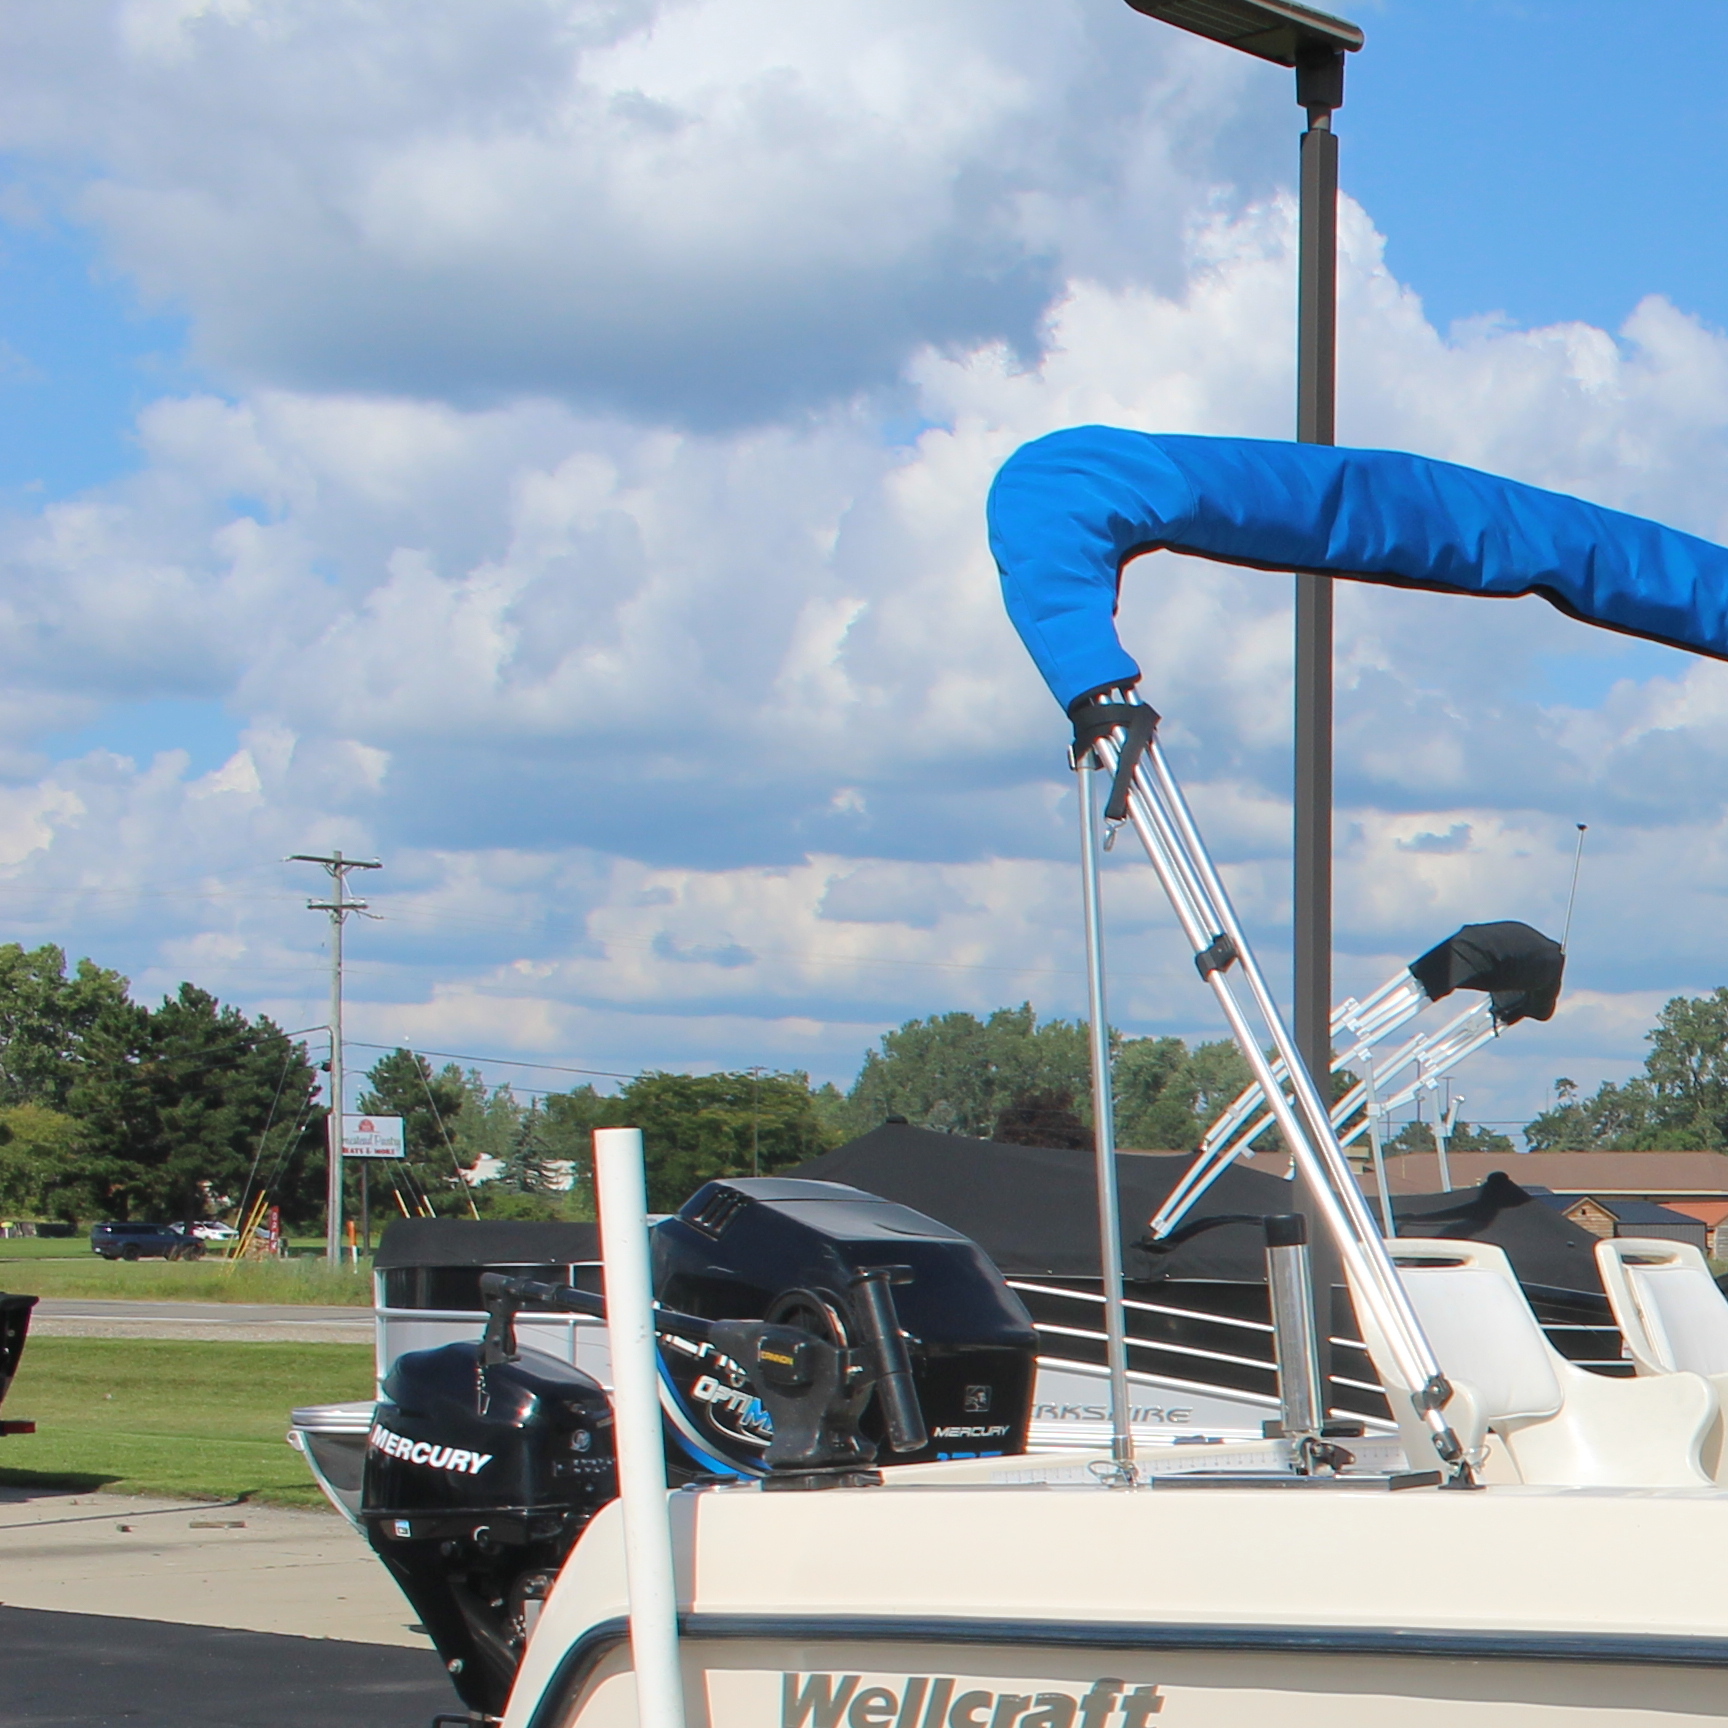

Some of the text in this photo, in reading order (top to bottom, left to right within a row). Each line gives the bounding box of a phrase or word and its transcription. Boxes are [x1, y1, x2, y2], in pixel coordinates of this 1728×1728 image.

[1033, 1402, 1193, 1424] RKSIRE
[933, 1424, 1011, 1439] MERCURY
[371, 1423, 493, 1475] MERCURY
